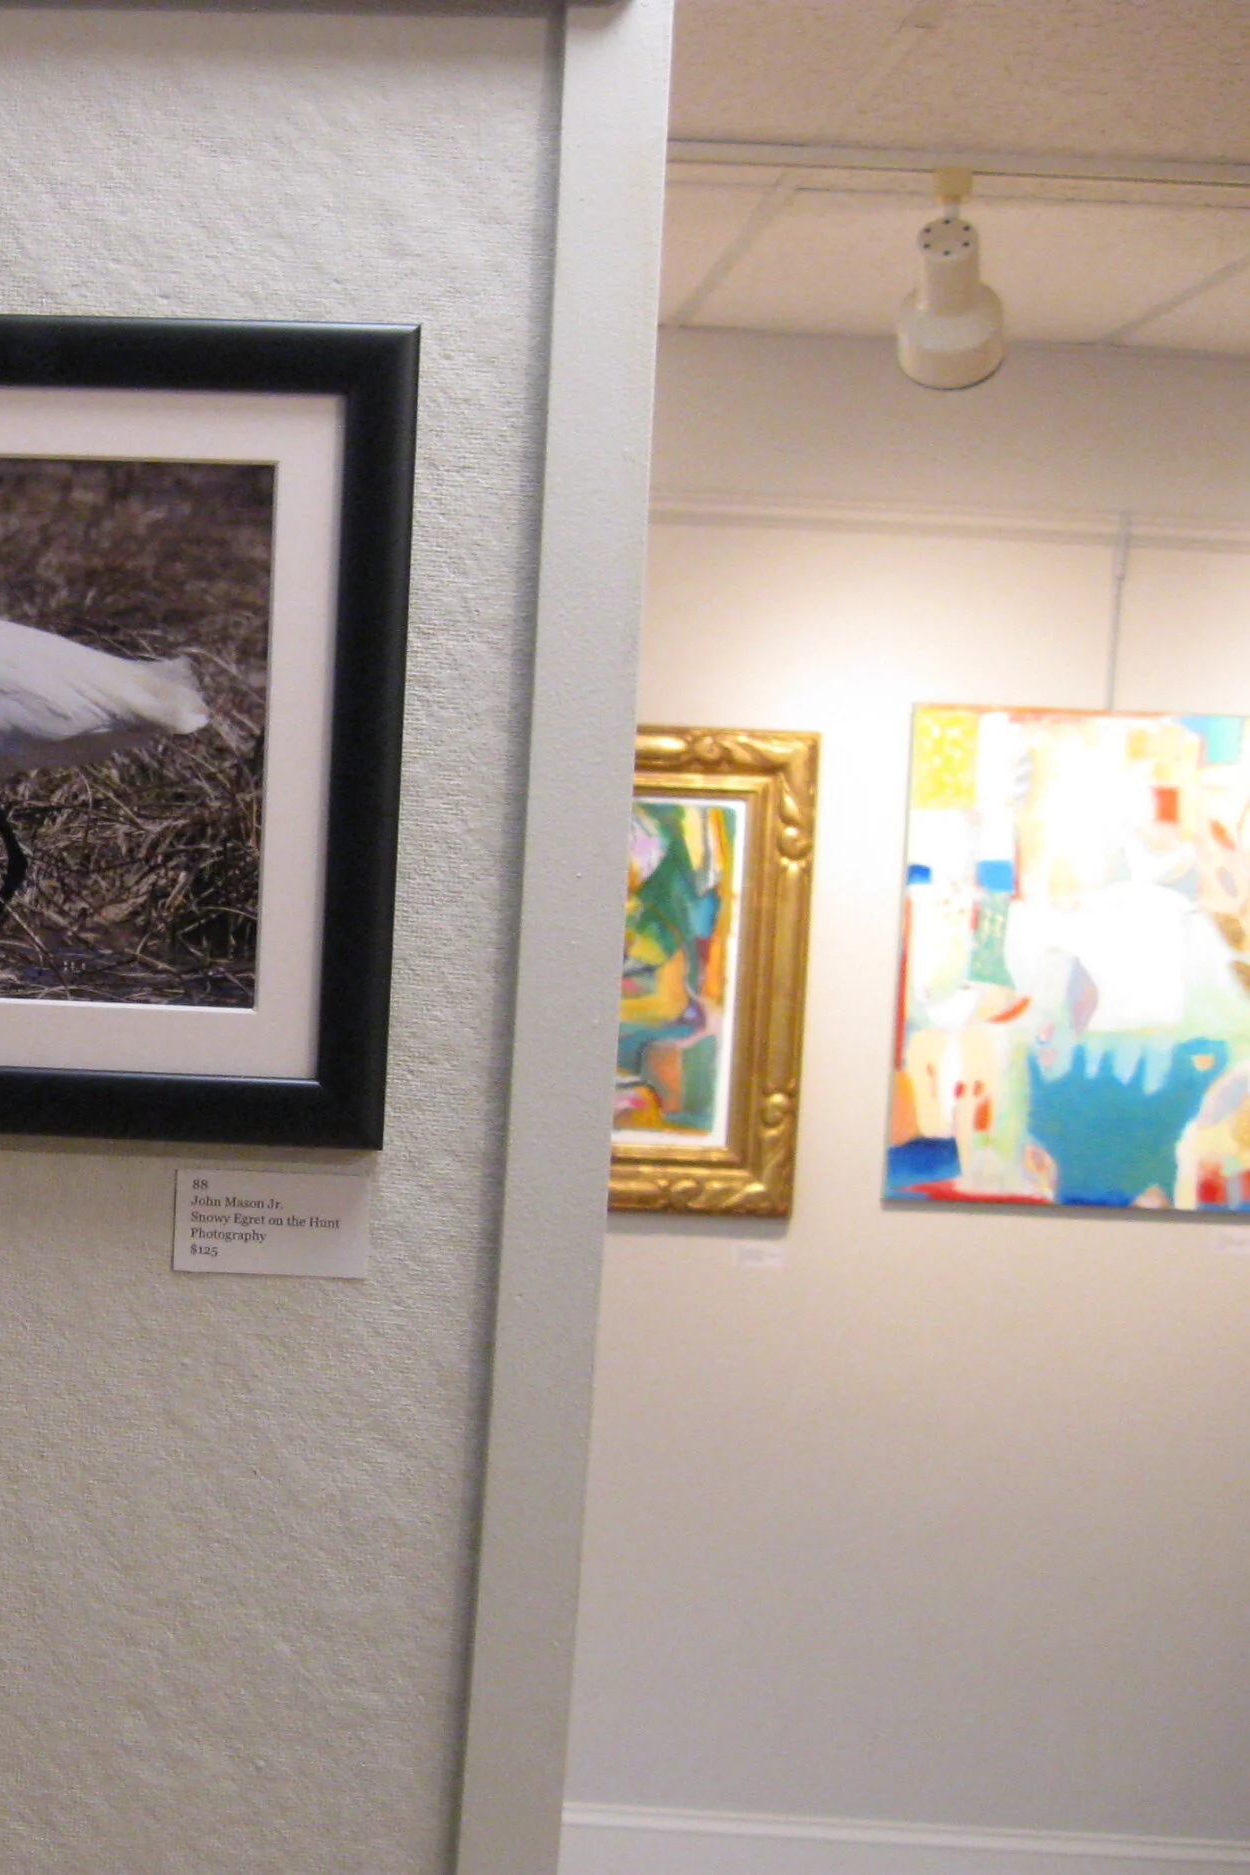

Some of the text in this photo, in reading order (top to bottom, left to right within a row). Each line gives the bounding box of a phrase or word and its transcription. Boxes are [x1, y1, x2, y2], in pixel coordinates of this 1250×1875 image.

[192, 1179, 209, 1190] 88
[191, 1195, 283, 1210] John Mason Jr.
[191, 1212, 340, 1229] Snowy Egret on the Hunt
[191, 1228, 267, 1243] Photography
[190, 1244, 218, 1257] $125
